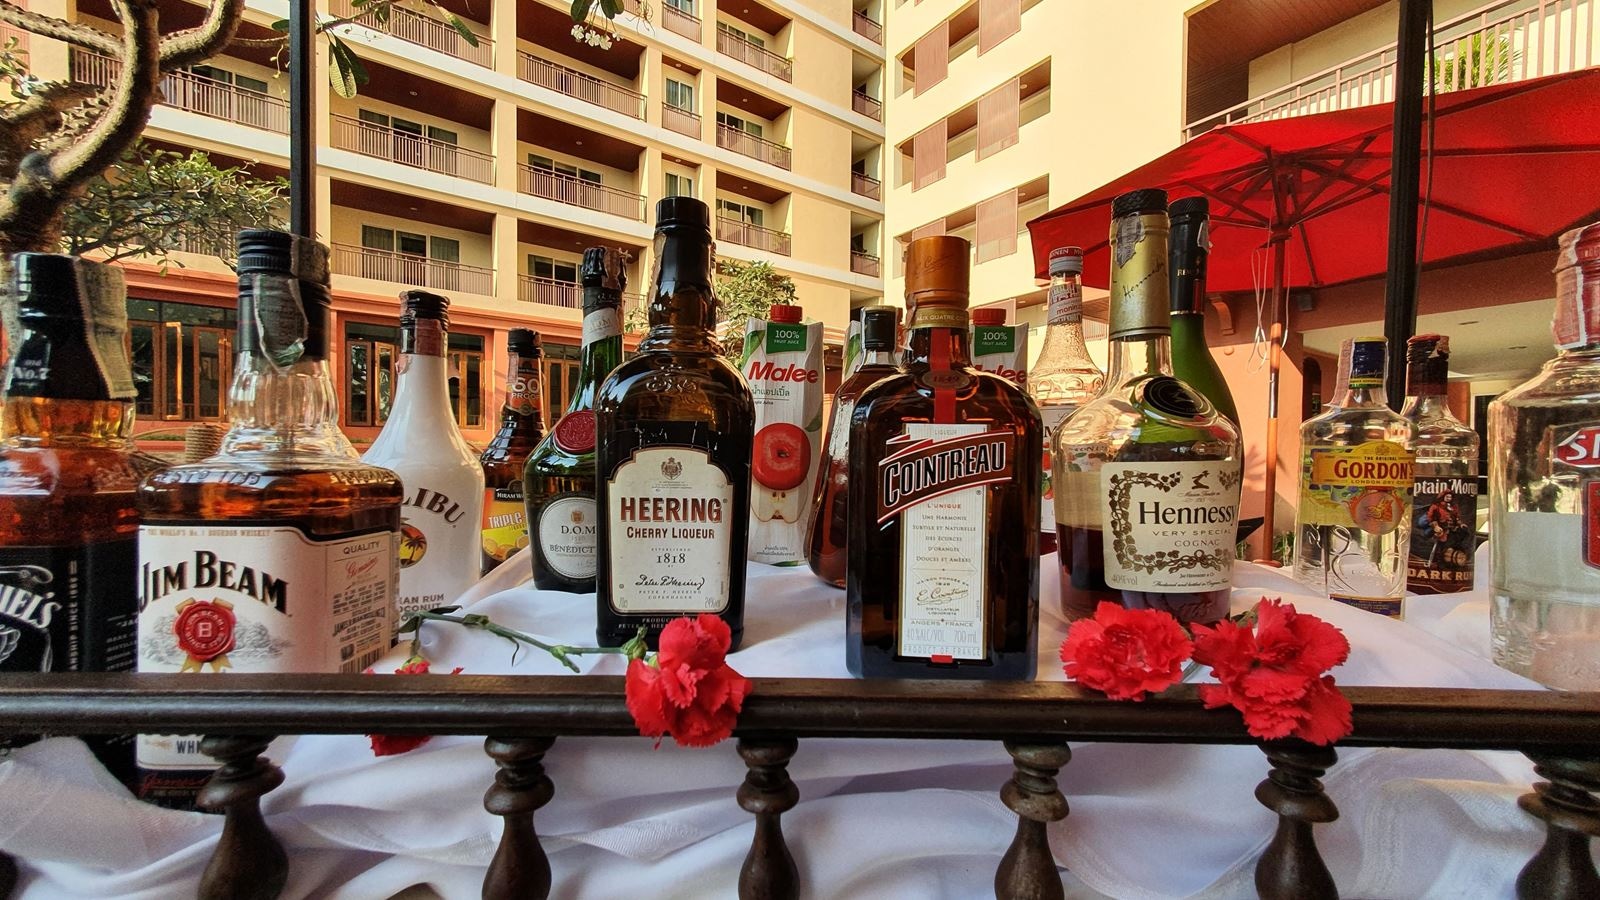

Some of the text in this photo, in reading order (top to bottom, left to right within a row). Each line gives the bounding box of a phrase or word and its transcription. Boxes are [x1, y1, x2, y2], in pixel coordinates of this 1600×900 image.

[775, 330, 800, 339] 100%
[983, 332, 1007, 341] 100%
[748, 361, 819, 383] Malee
[884, 441, 1007, 508] COINTREAU
[1334, 459, 1414, 480] GORDON'S
[1413, 479, 1448, 497] ptain
[620, 497, 723, 524] HEERING
[1138, 501, 1237, 527] Hennessy
[626, 526, 716, 539] CHERRY LIQUEUR
[343, 541, 380, 555] QUALITY
[1174, 539, 1220, 547] COGNAC
[656, 552, 686, 564] 1818
[1407, 569, 1451, 580] DARK
[139, 561, 189, 614] JIM
[192, 550, 292, 619] BEAM
[422, 593, 446, 603] RUM
